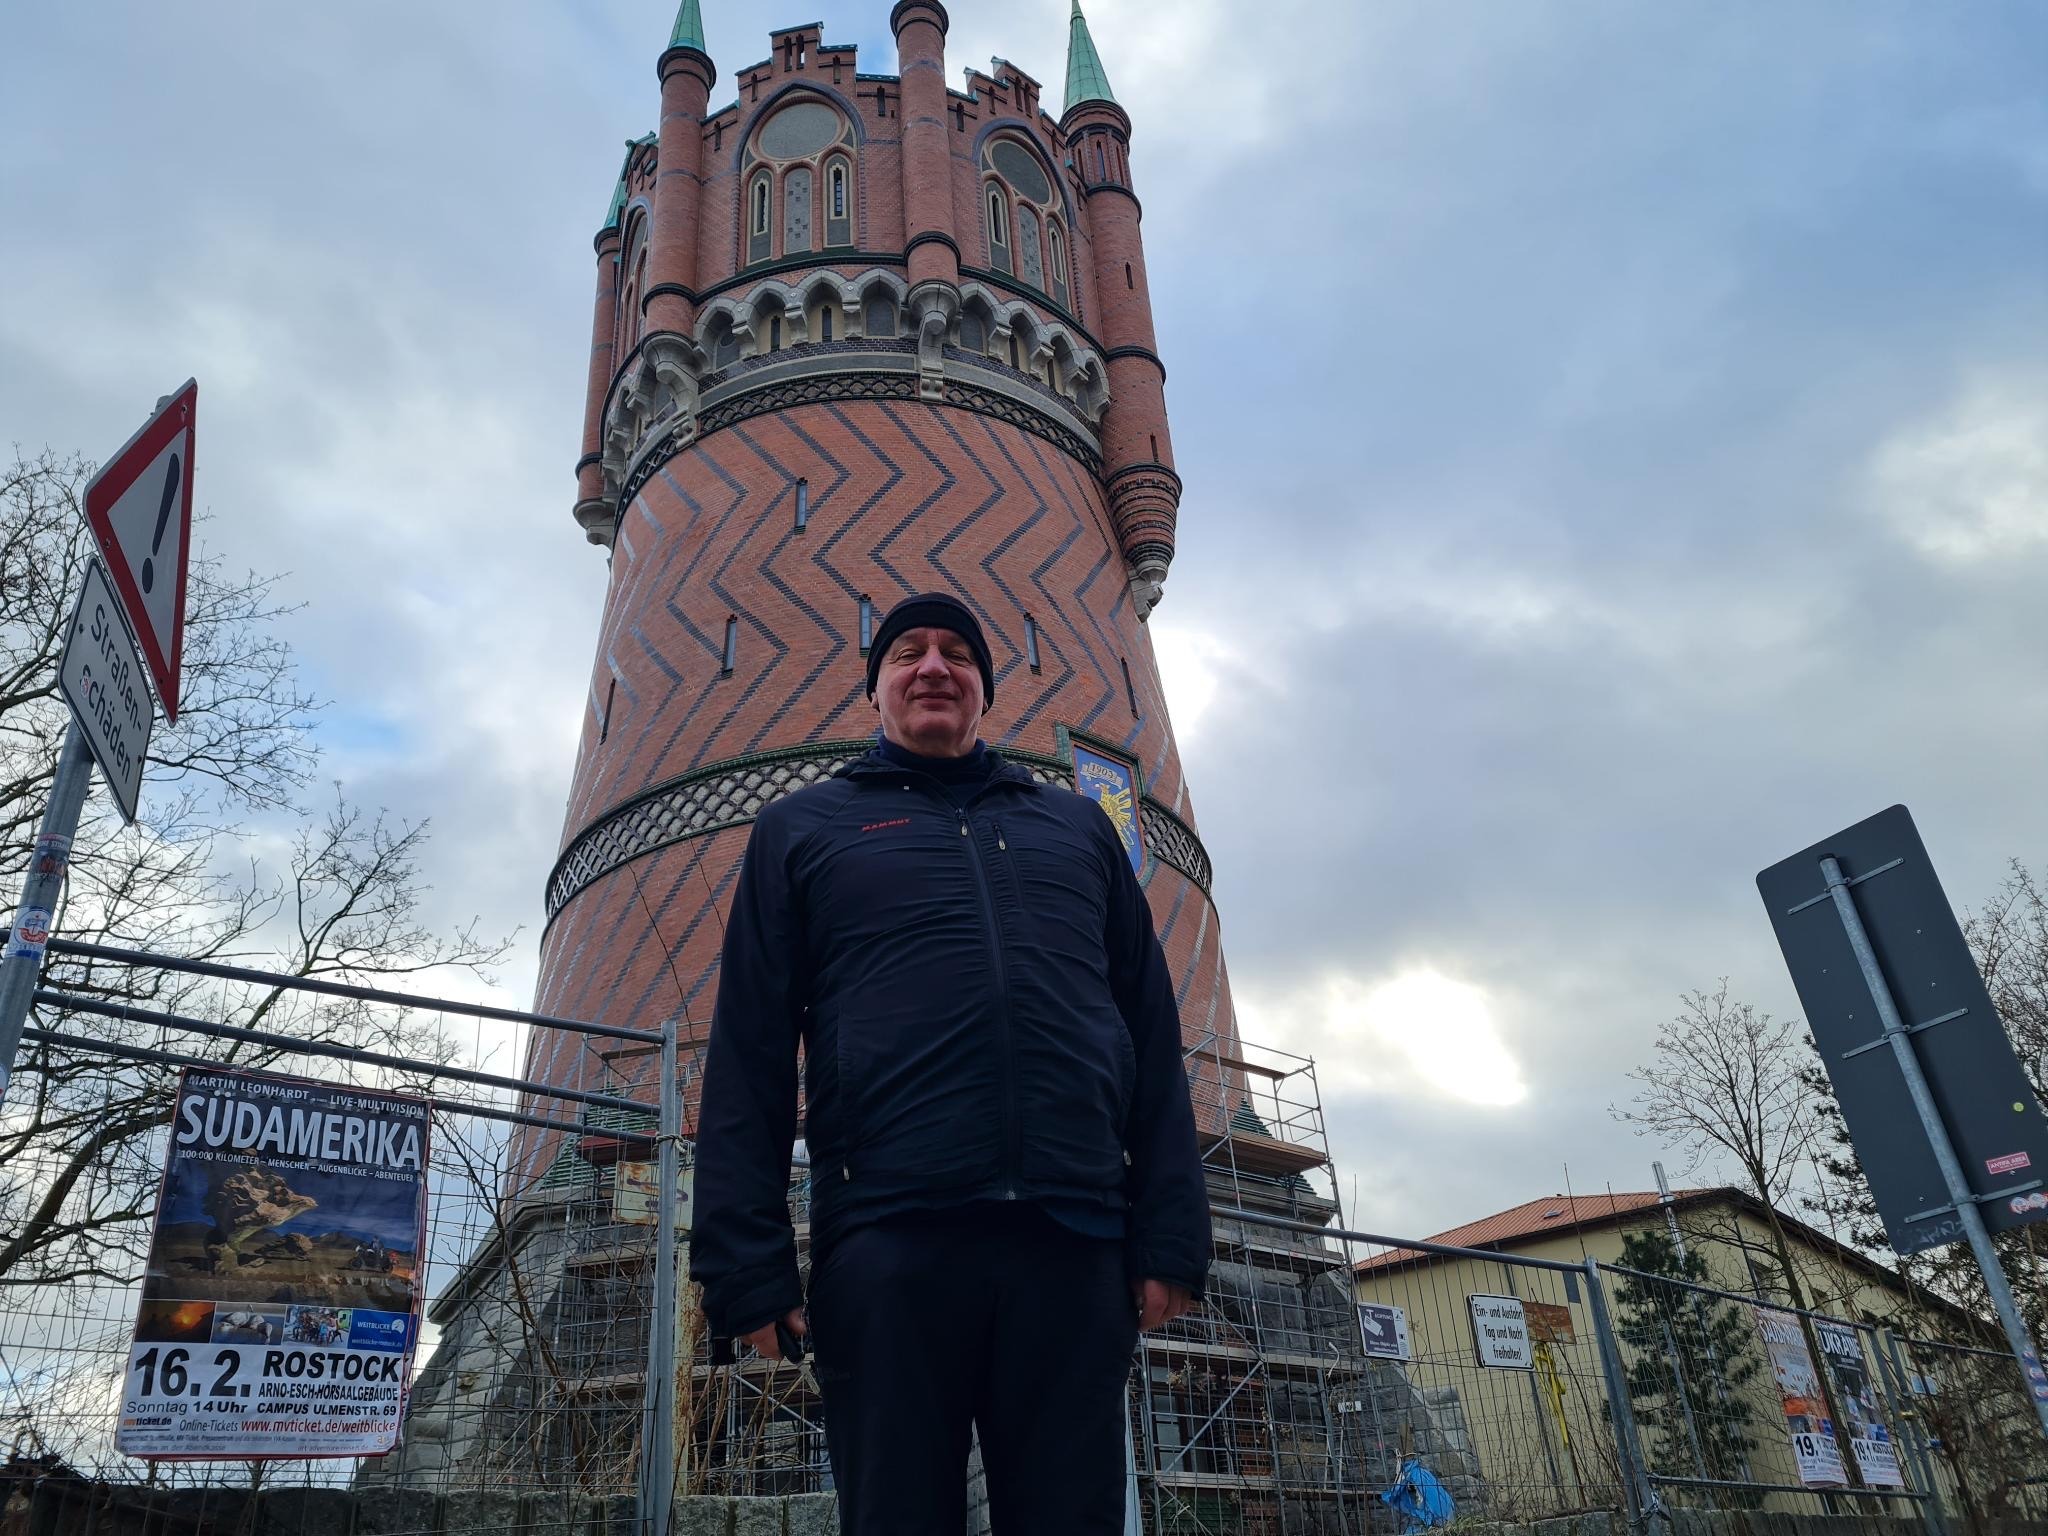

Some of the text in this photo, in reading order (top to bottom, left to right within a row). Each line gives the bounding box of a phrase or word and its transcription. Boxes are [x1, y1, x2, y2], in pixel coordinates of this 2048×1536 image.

[91, 604, 142, 731] Straßen-
[188, 1075, 425, 1117] MARTIN LEONHARDT LIVE-MULTIVISION
[176, 1089, 422, 1171] SÜDAMERIKA
[181, 1150, 213, 1161] 100.000
[216, 1152, 259, 1165] KILOMETER
[268, 1158, 309, 1171] MENSCHEN
[318, 1163, 367, 1177] AUGENBLICKE
[375, 1170, 414, 1183] ABENTEUER
[1474, 1304, 1488, 1317] Ein-
[1490, 1304, 1501, 1317] und
[358, 1321, 390, 1330] WEITBLICKE
[1483, 1324, 1496, 1341] Tag
[1496, 1325, 1507, 1339] und
[1819, 1330, 1864, 1360] UKRAINE
[262, 1351, 402, 1383] ROSTOCK
[258, 1381, 398, 1401] ARNO-ESCH-HÖRSAALGEBÄUDE
[126, 1401, 248, 1415] Sonntag 14 Uhr
[257, 1403, 397, 1416] CAMPUS ULMENSTR. 69
[180, 1418, 396, 1434] Online-Tickets www.mvticket.de/weitblicke
